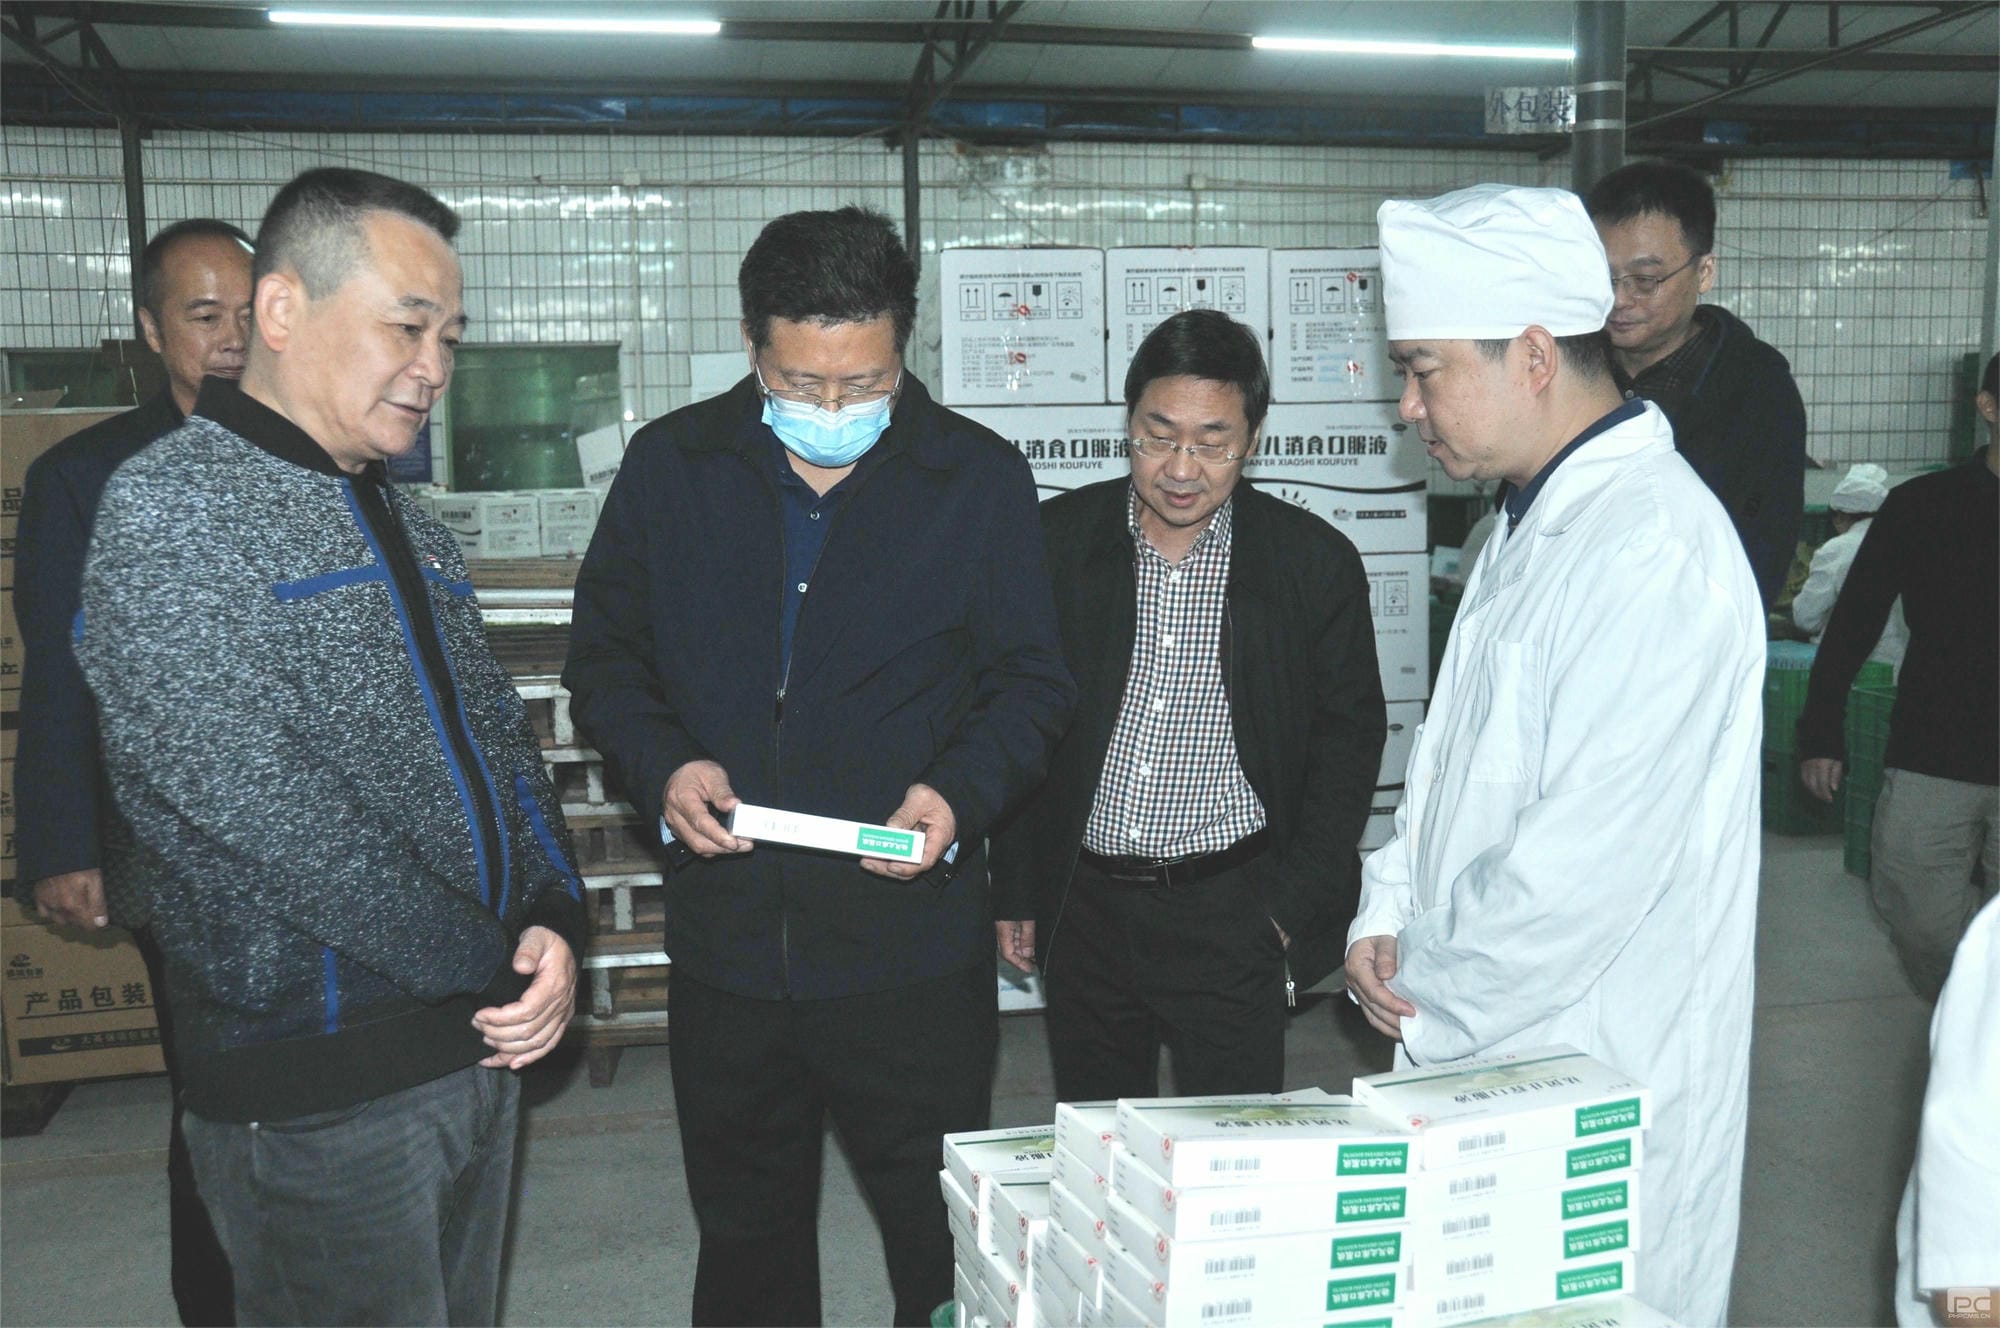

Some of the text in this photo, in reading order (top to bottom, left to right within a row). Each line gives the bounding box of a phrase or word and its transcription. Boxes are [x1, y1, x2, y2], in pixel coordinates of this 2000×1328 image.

[1490, 91, 1572, 124] 外包装
[1256, 435, 1387, 456] 儿消食口服液
[1059, 461, 1103, 469] KOUFUYE
[1278, 458, 1315, 467] XIAOSHI
[1317, 458, 1359, 467] KOUFUYE
[26, 982, 146, 1014] 产品包装
